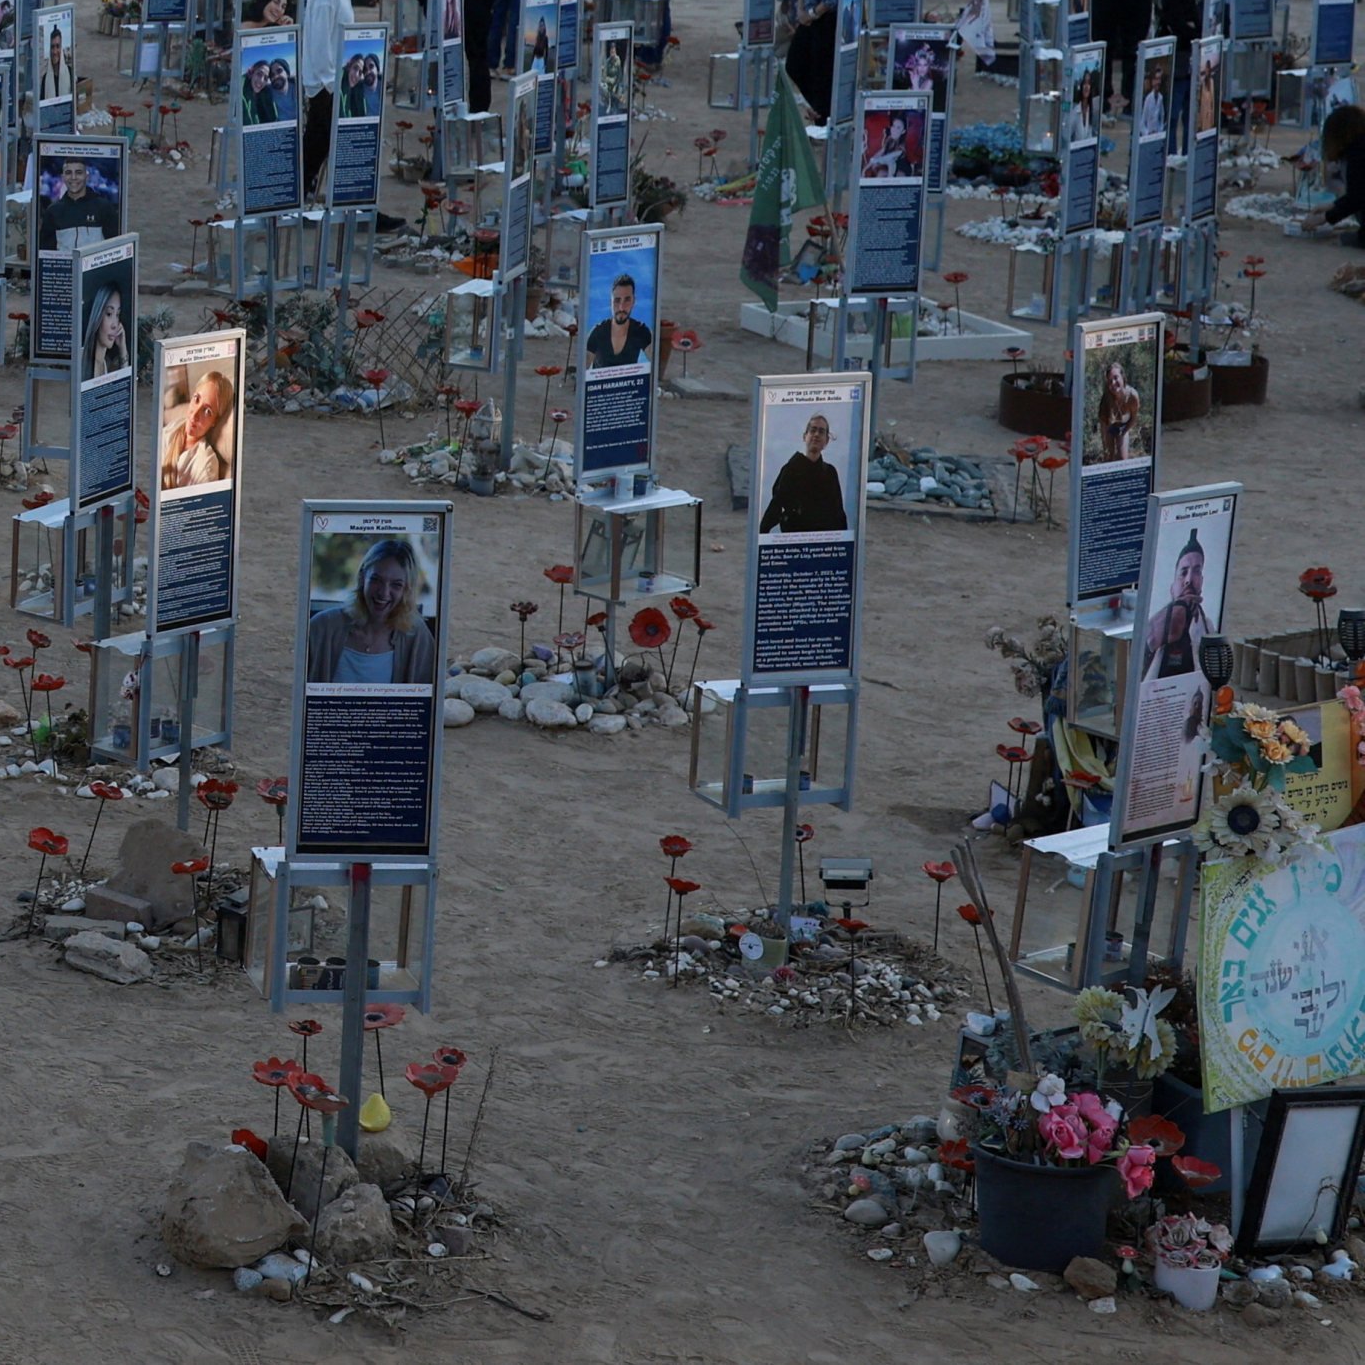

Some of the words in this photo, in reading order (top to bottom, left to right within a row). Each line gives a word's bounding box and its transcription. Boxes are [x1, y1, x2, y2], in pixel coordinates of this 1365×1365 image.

[603, 380, 636, 389] HARAMATY,
[1315, 784, 1329, 796] מעין
[1331, 780, 1348, 790] ניסים
[1288, 789, 1303, 798] מרים
[1305, 787, 1312, 797] בן
[1293, 923, 1329, 962] אני
[1218, 959, 1246, 1024] באר
